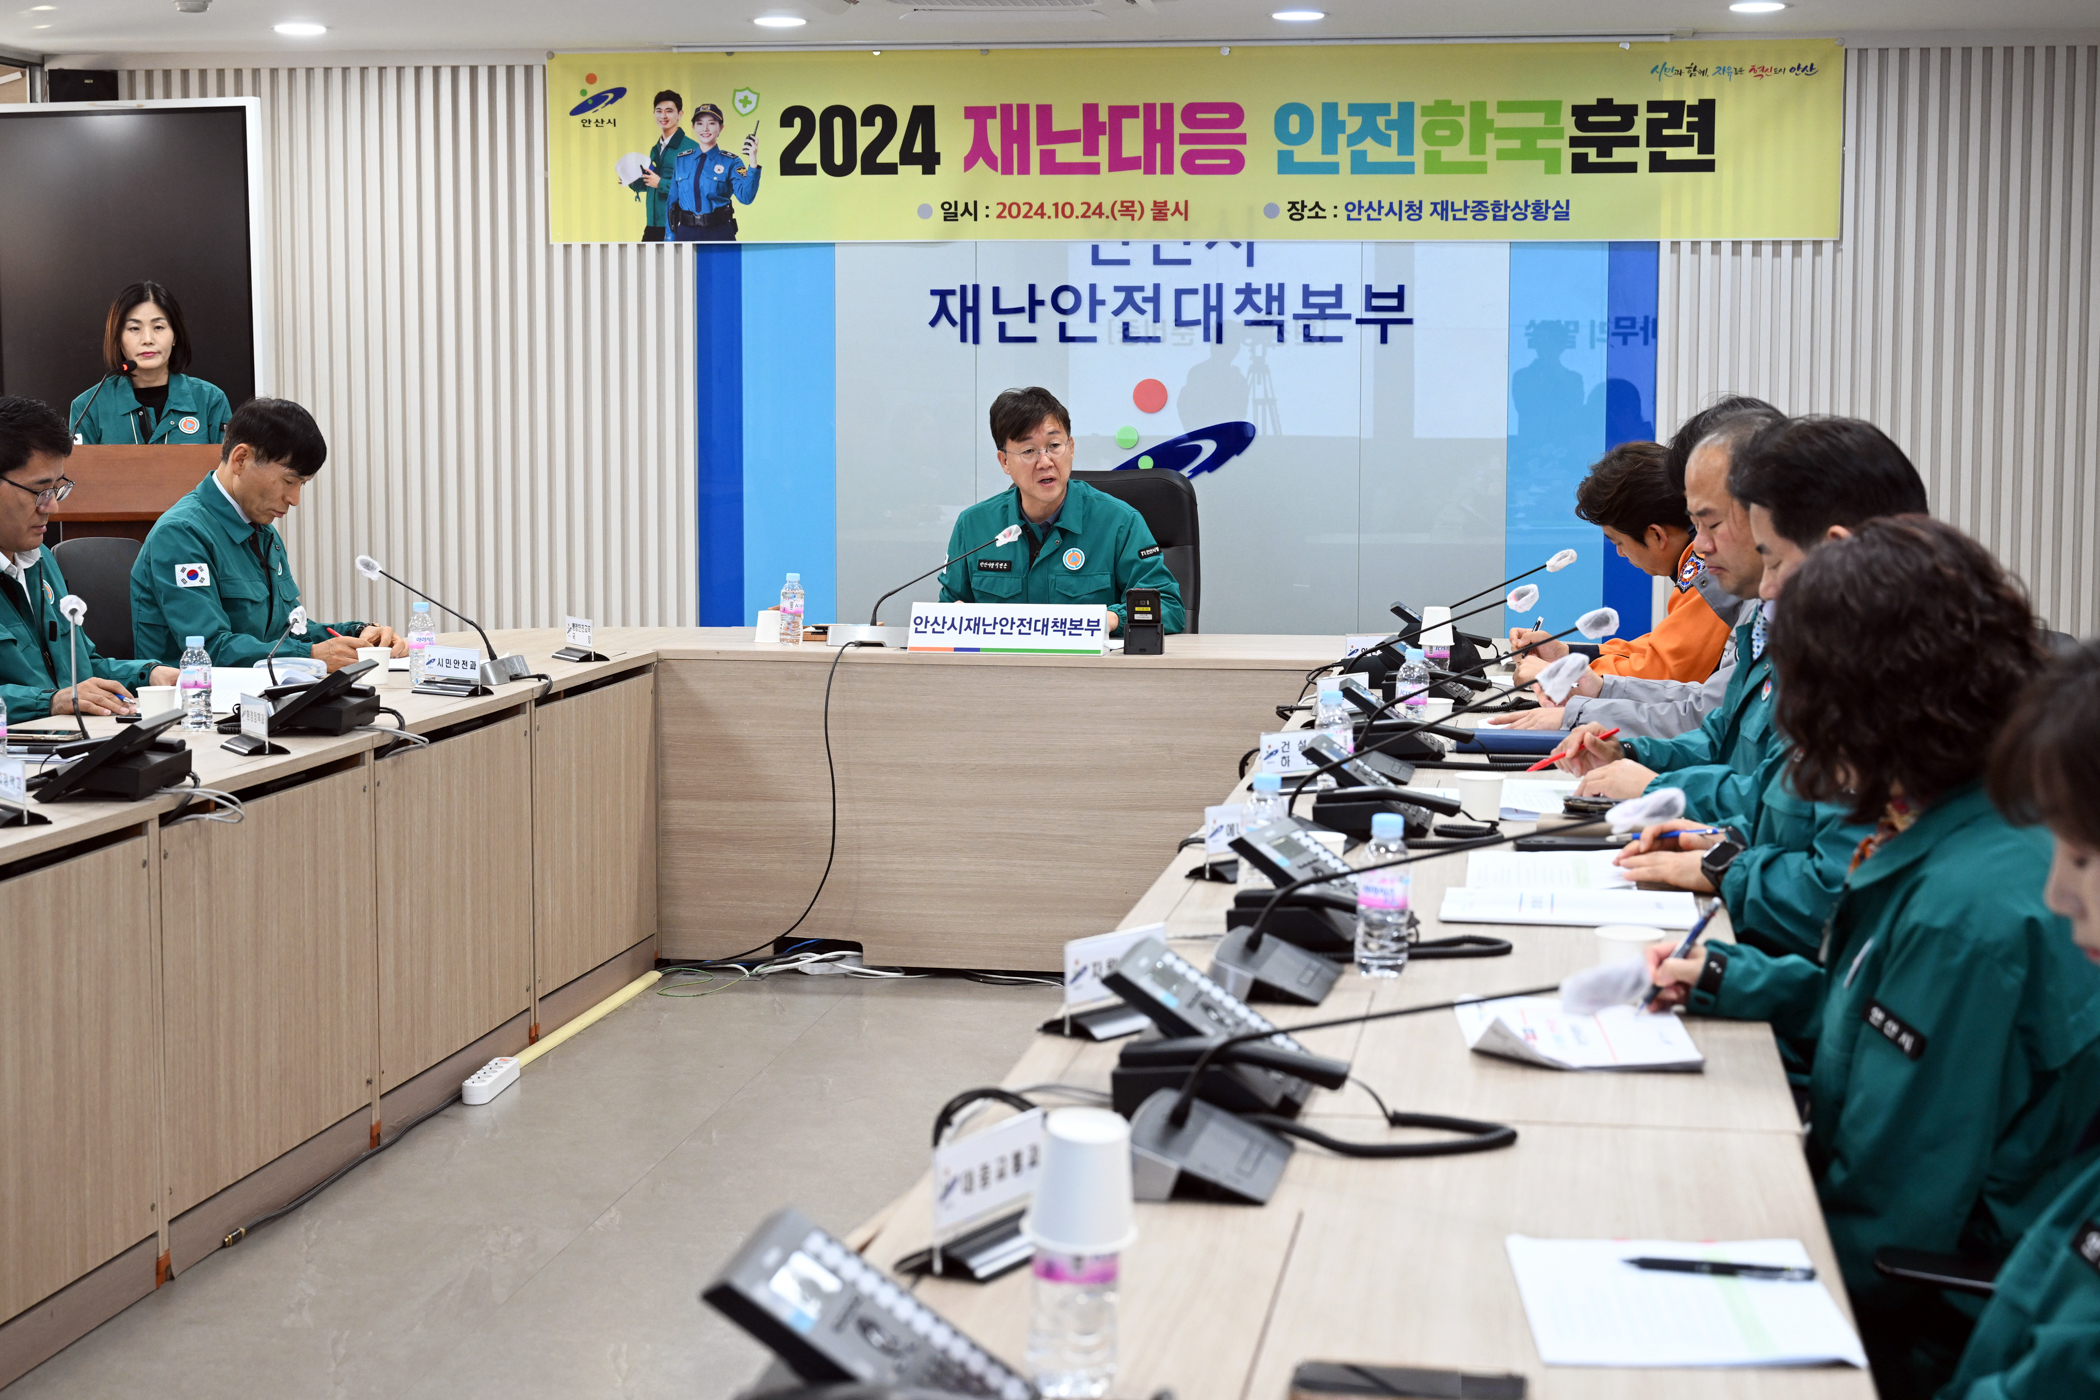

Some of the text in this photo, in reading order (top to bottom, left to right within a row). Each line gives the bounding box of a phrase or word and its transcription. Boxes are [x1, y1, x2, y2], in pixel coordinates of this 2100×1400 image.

[1789, 62, 1819, 76] 안산
[580, 118, 617, 128] 안산시
[779, 97, 1716, 178] 2024 재난대응 안전한국훈련
[940, 200, 978, 222] 일시
[995, 200, 1145, 222] 2024.10.24.(목)
[1150, 200, 1189, 222] 불시
[1286, 199, 1328, 221] 장소
[1344, 199, 1424, 222] 안산시청
[1429, 198, 1571, 222] 재난종합상황실
[927, 281, 1414, 345] 재난안전대책본부
[912, 615, 1102, 638] 안산시재난안전대책본부
[436, 657, 477, 671] 시민안전과
